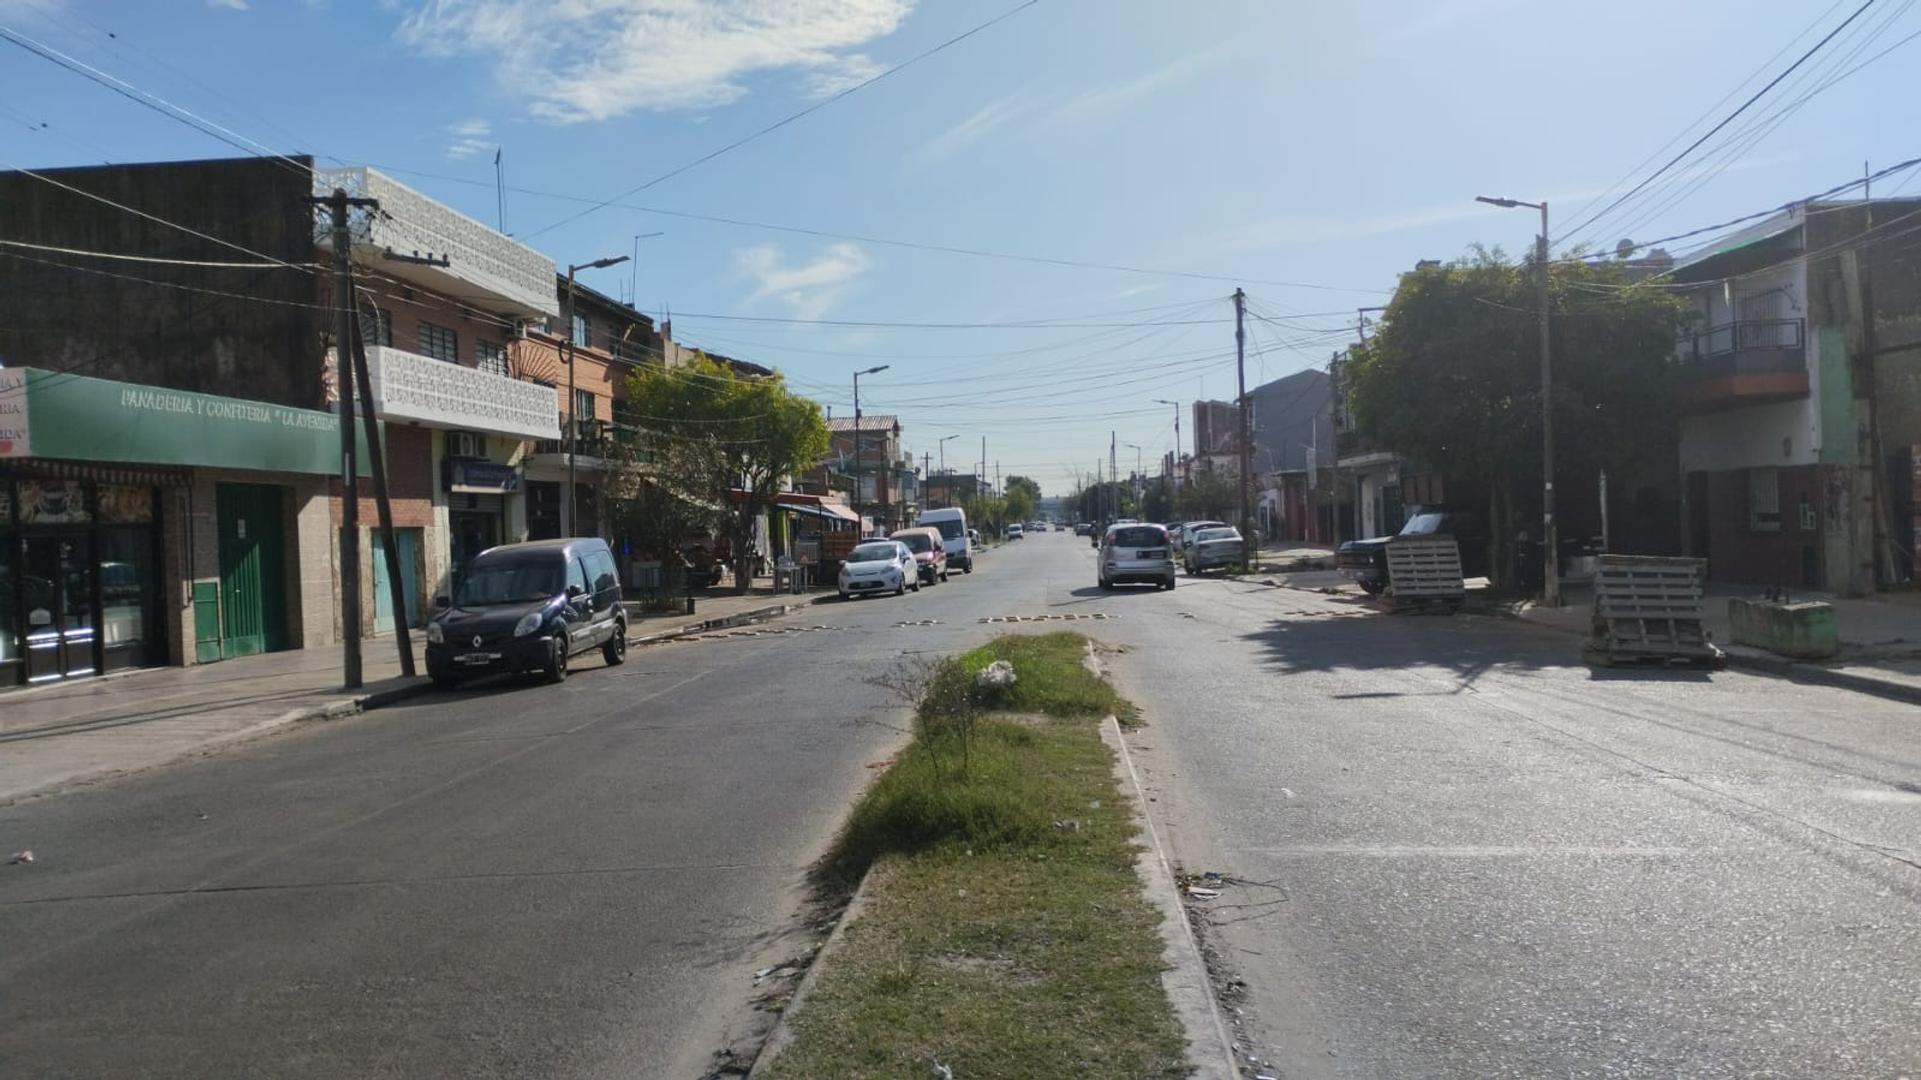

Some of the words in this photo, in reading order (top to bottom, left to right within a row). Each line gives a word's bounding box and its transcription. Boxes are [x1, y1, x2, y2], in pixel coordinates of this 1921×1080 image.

[121, 388, 194, 414] PANADERIA
[196, 398, 206, 415] Y
[206, 401, 272, 424] CONFITERIA
